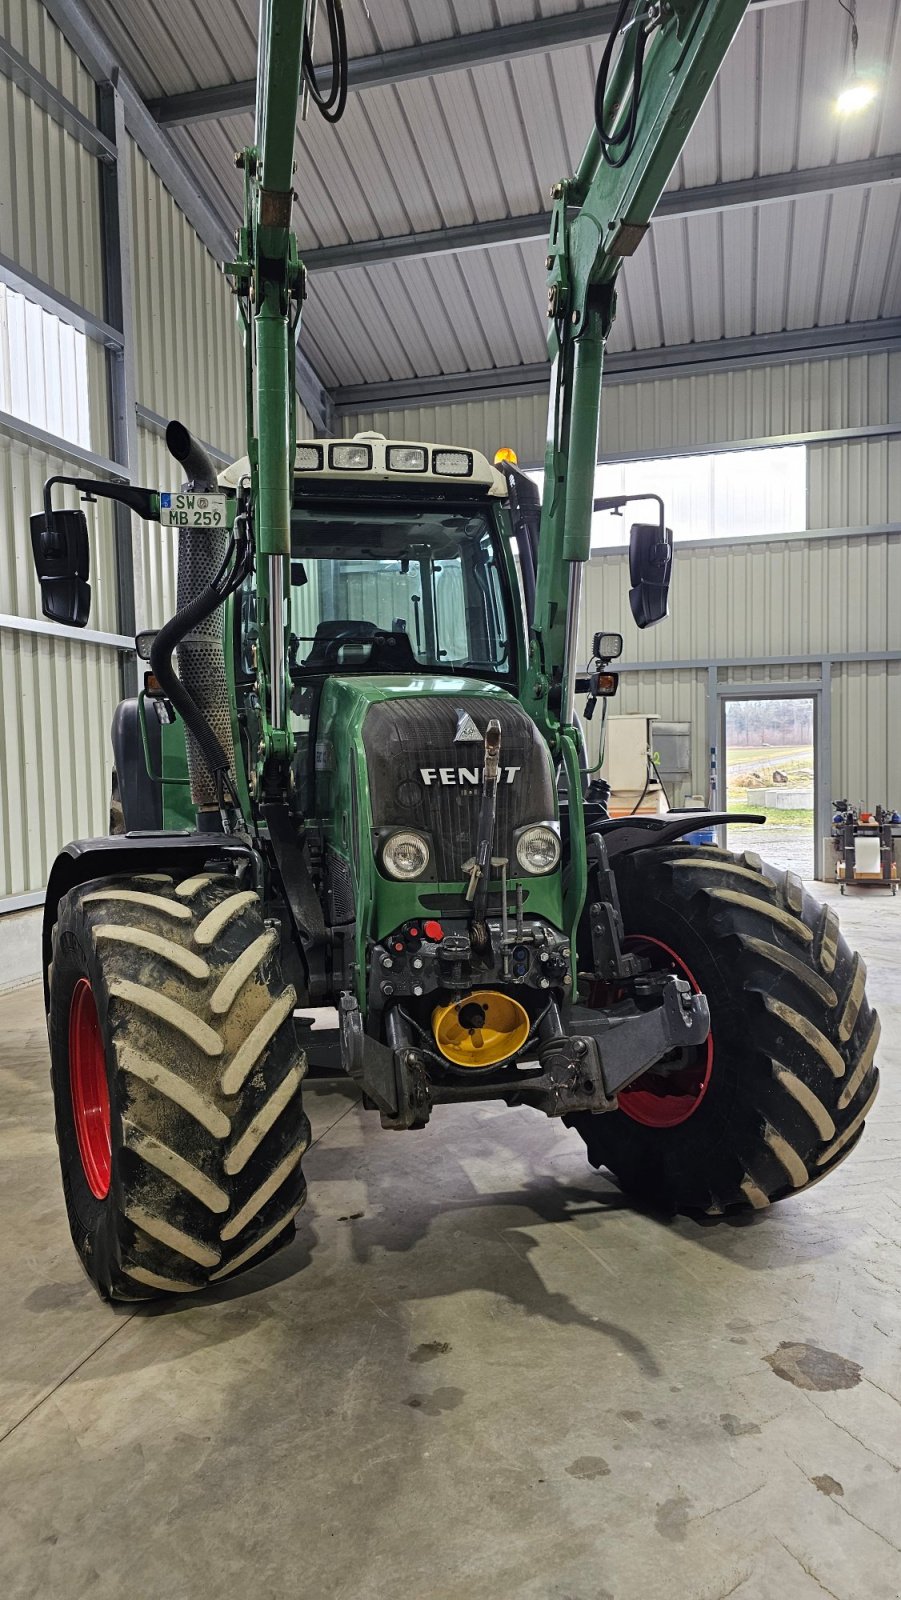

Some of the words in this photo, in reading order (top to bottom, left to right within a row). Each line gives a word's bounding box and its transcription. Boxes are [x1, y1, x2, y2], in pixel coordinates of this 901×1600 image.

[176, 494, 195, 509] SW
[170, 511, 189, 525] MB
[193, 511, 222, 526] 259
